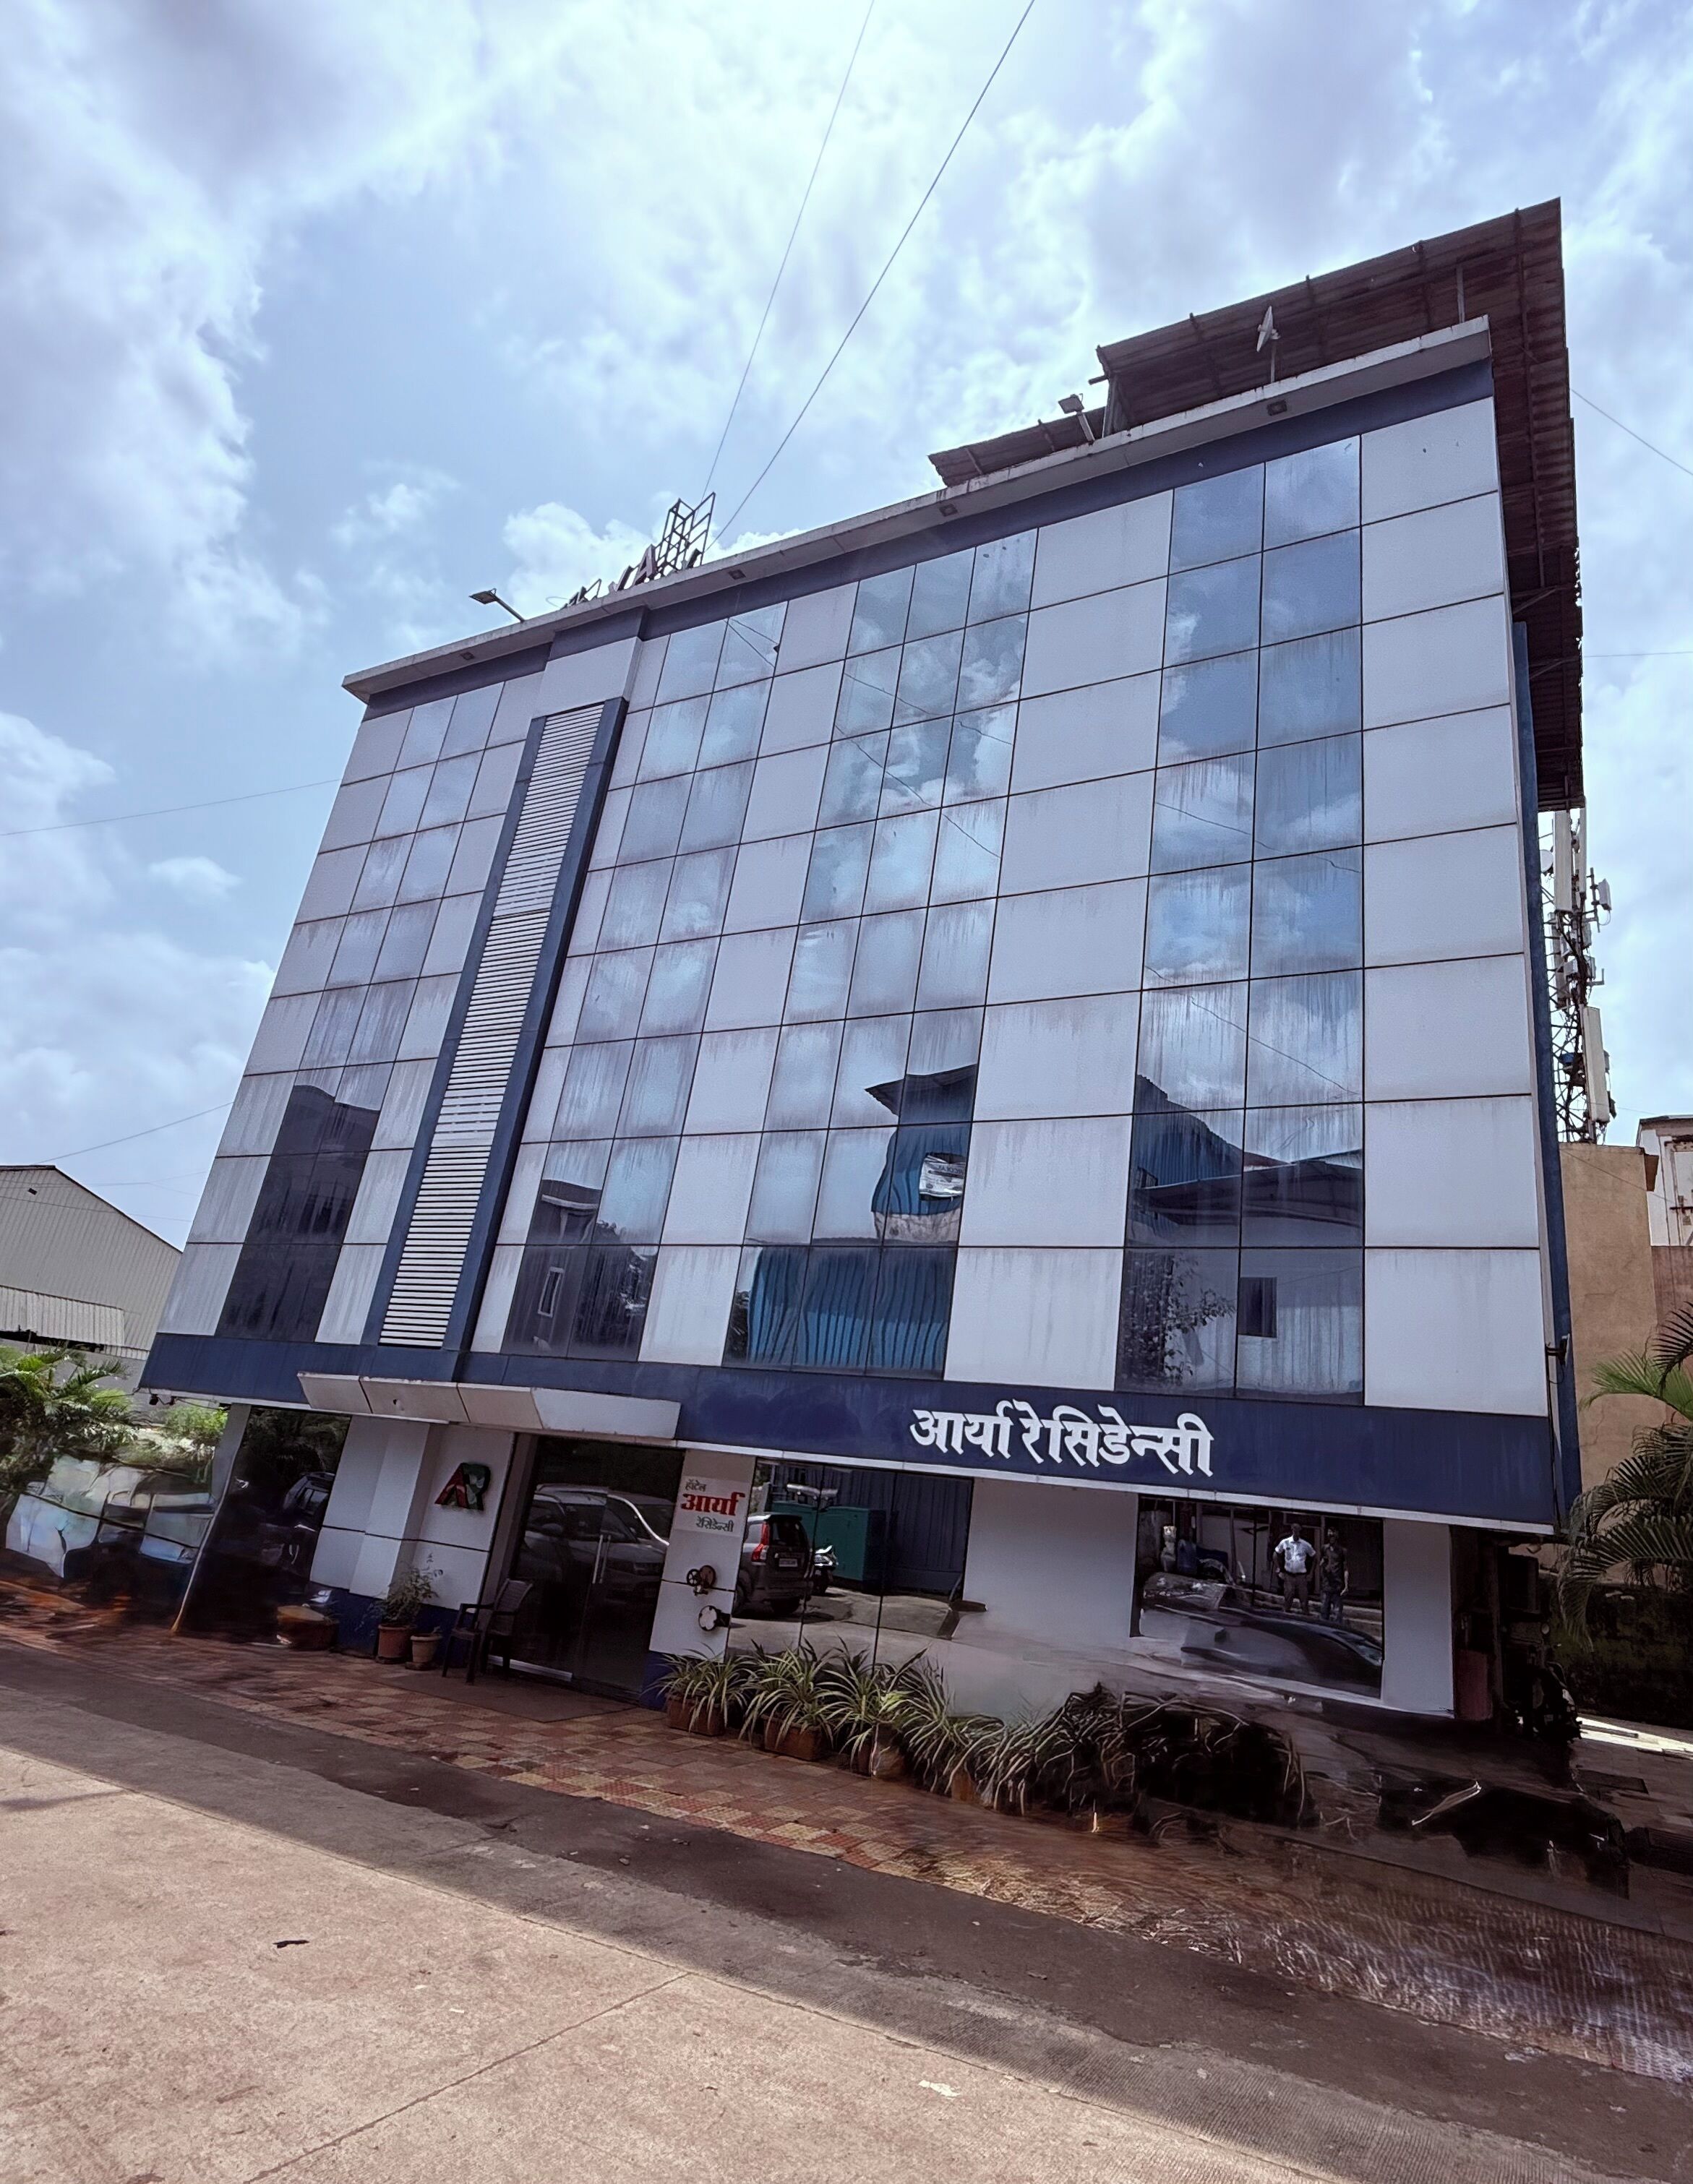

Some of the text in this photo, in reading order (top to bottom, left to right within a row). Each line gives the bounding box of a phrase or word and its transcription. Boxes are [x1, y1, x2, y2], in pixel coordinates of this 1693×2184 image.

[909, 1398, 1215, 1478] आर्या रेसिडेन्सी
[680, 1491, 746, 1516] आर्या
